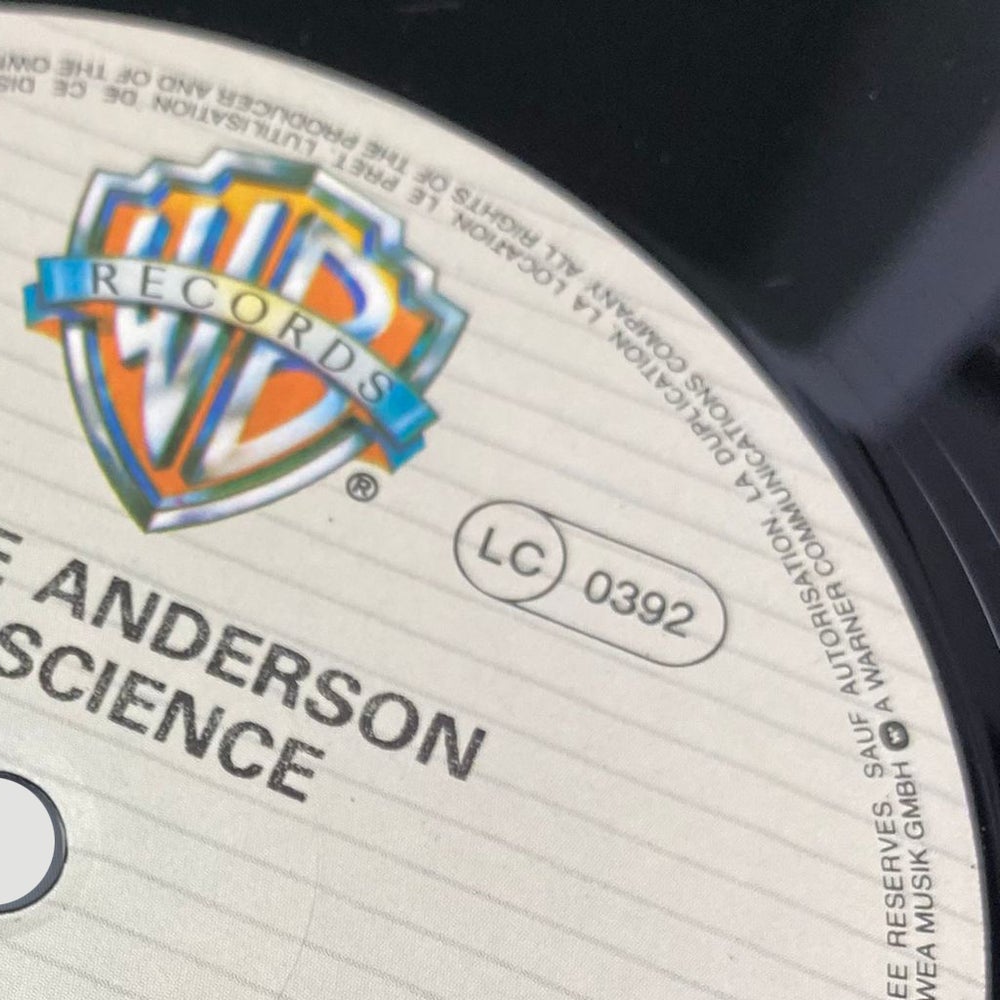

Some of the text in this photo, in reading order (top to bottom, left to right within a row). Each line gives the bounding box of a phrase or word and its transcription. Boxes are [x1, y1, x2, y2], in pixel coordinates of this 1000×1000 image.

[91, 262, 394, 404] RECORDS
[583, 279, 689, 374] COMPANY
[683, 372, 836, 578] COMMUNICATIONS
[733, 470, 764, 503] LA
[477, 525, 696, 639] LC 0392
[31, 557, 487, 781] ANDERSON
[824, 580, 886, 692] WARNER
[848, 712, 886, 779] SAUF
[872, 695, 894, 713] A
[890, 760, 926, 841] GMBH
[907, 848, 936, 934] MUSIK
